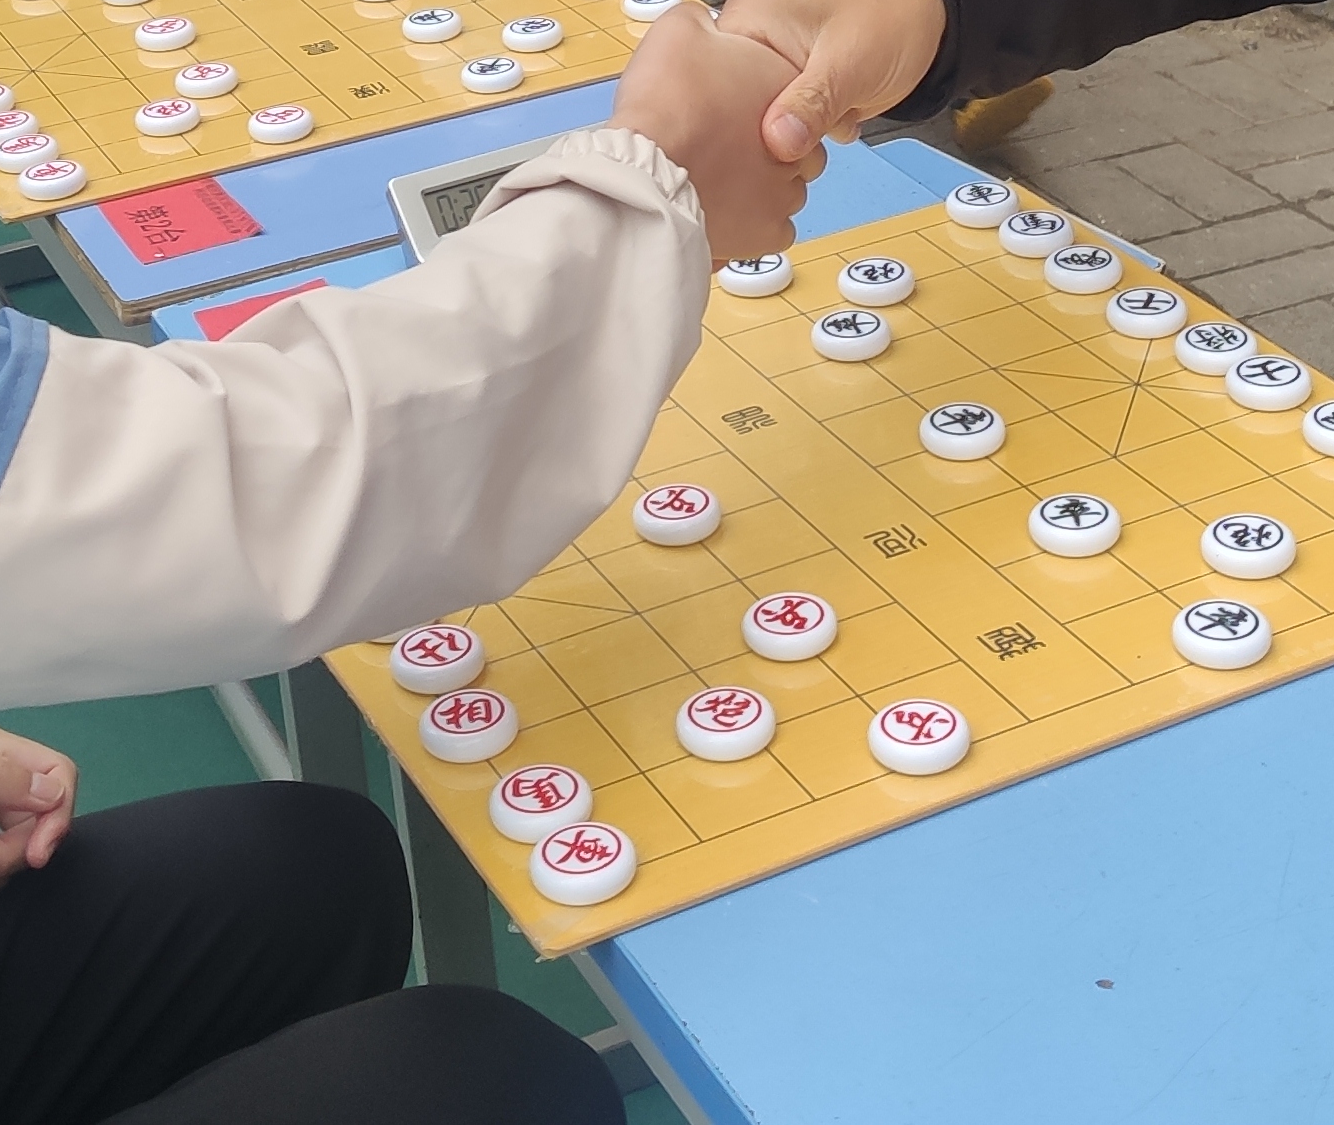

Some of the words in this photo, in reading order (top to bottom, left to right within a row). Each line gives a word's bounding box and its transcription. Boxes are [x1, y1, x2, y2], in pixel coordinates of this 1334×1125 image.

[1122, 291, 1172, 311] 士
[1243, 359, 1293, 381] 士
[406, 630, 463, 662] 仕
[436, 697, 492, 729] 相
[511, 771, 566, 809] 馬
